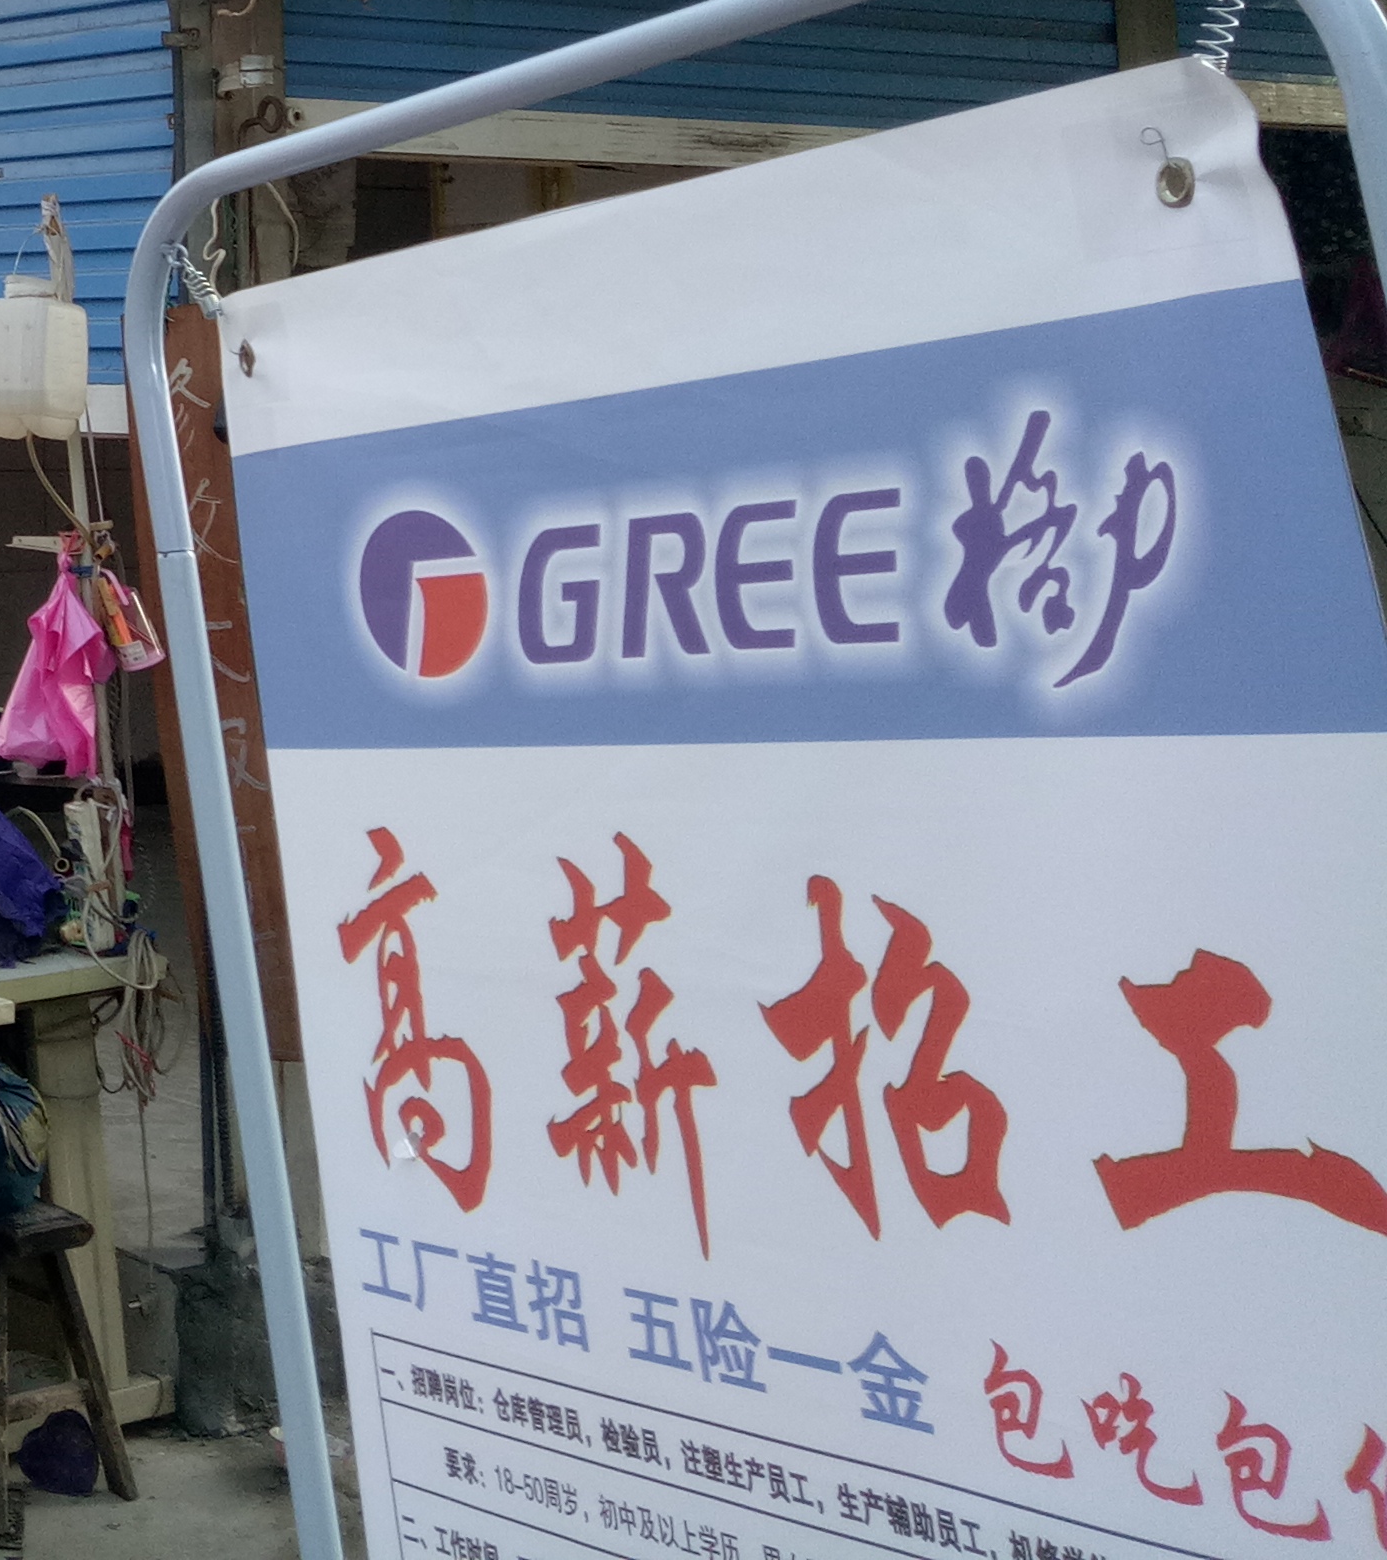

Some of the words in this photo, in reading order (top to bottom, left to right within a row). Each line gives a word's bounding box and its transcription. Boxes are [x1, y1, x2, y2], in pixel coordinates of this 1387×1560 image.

[518, 488, 900, 664] GREE
[338, 827, 1387, 1260] 高薪招工
[359, 1228, 590, 1352] 工厂直招
[624, 1287, 935, 1435] 五险一金
